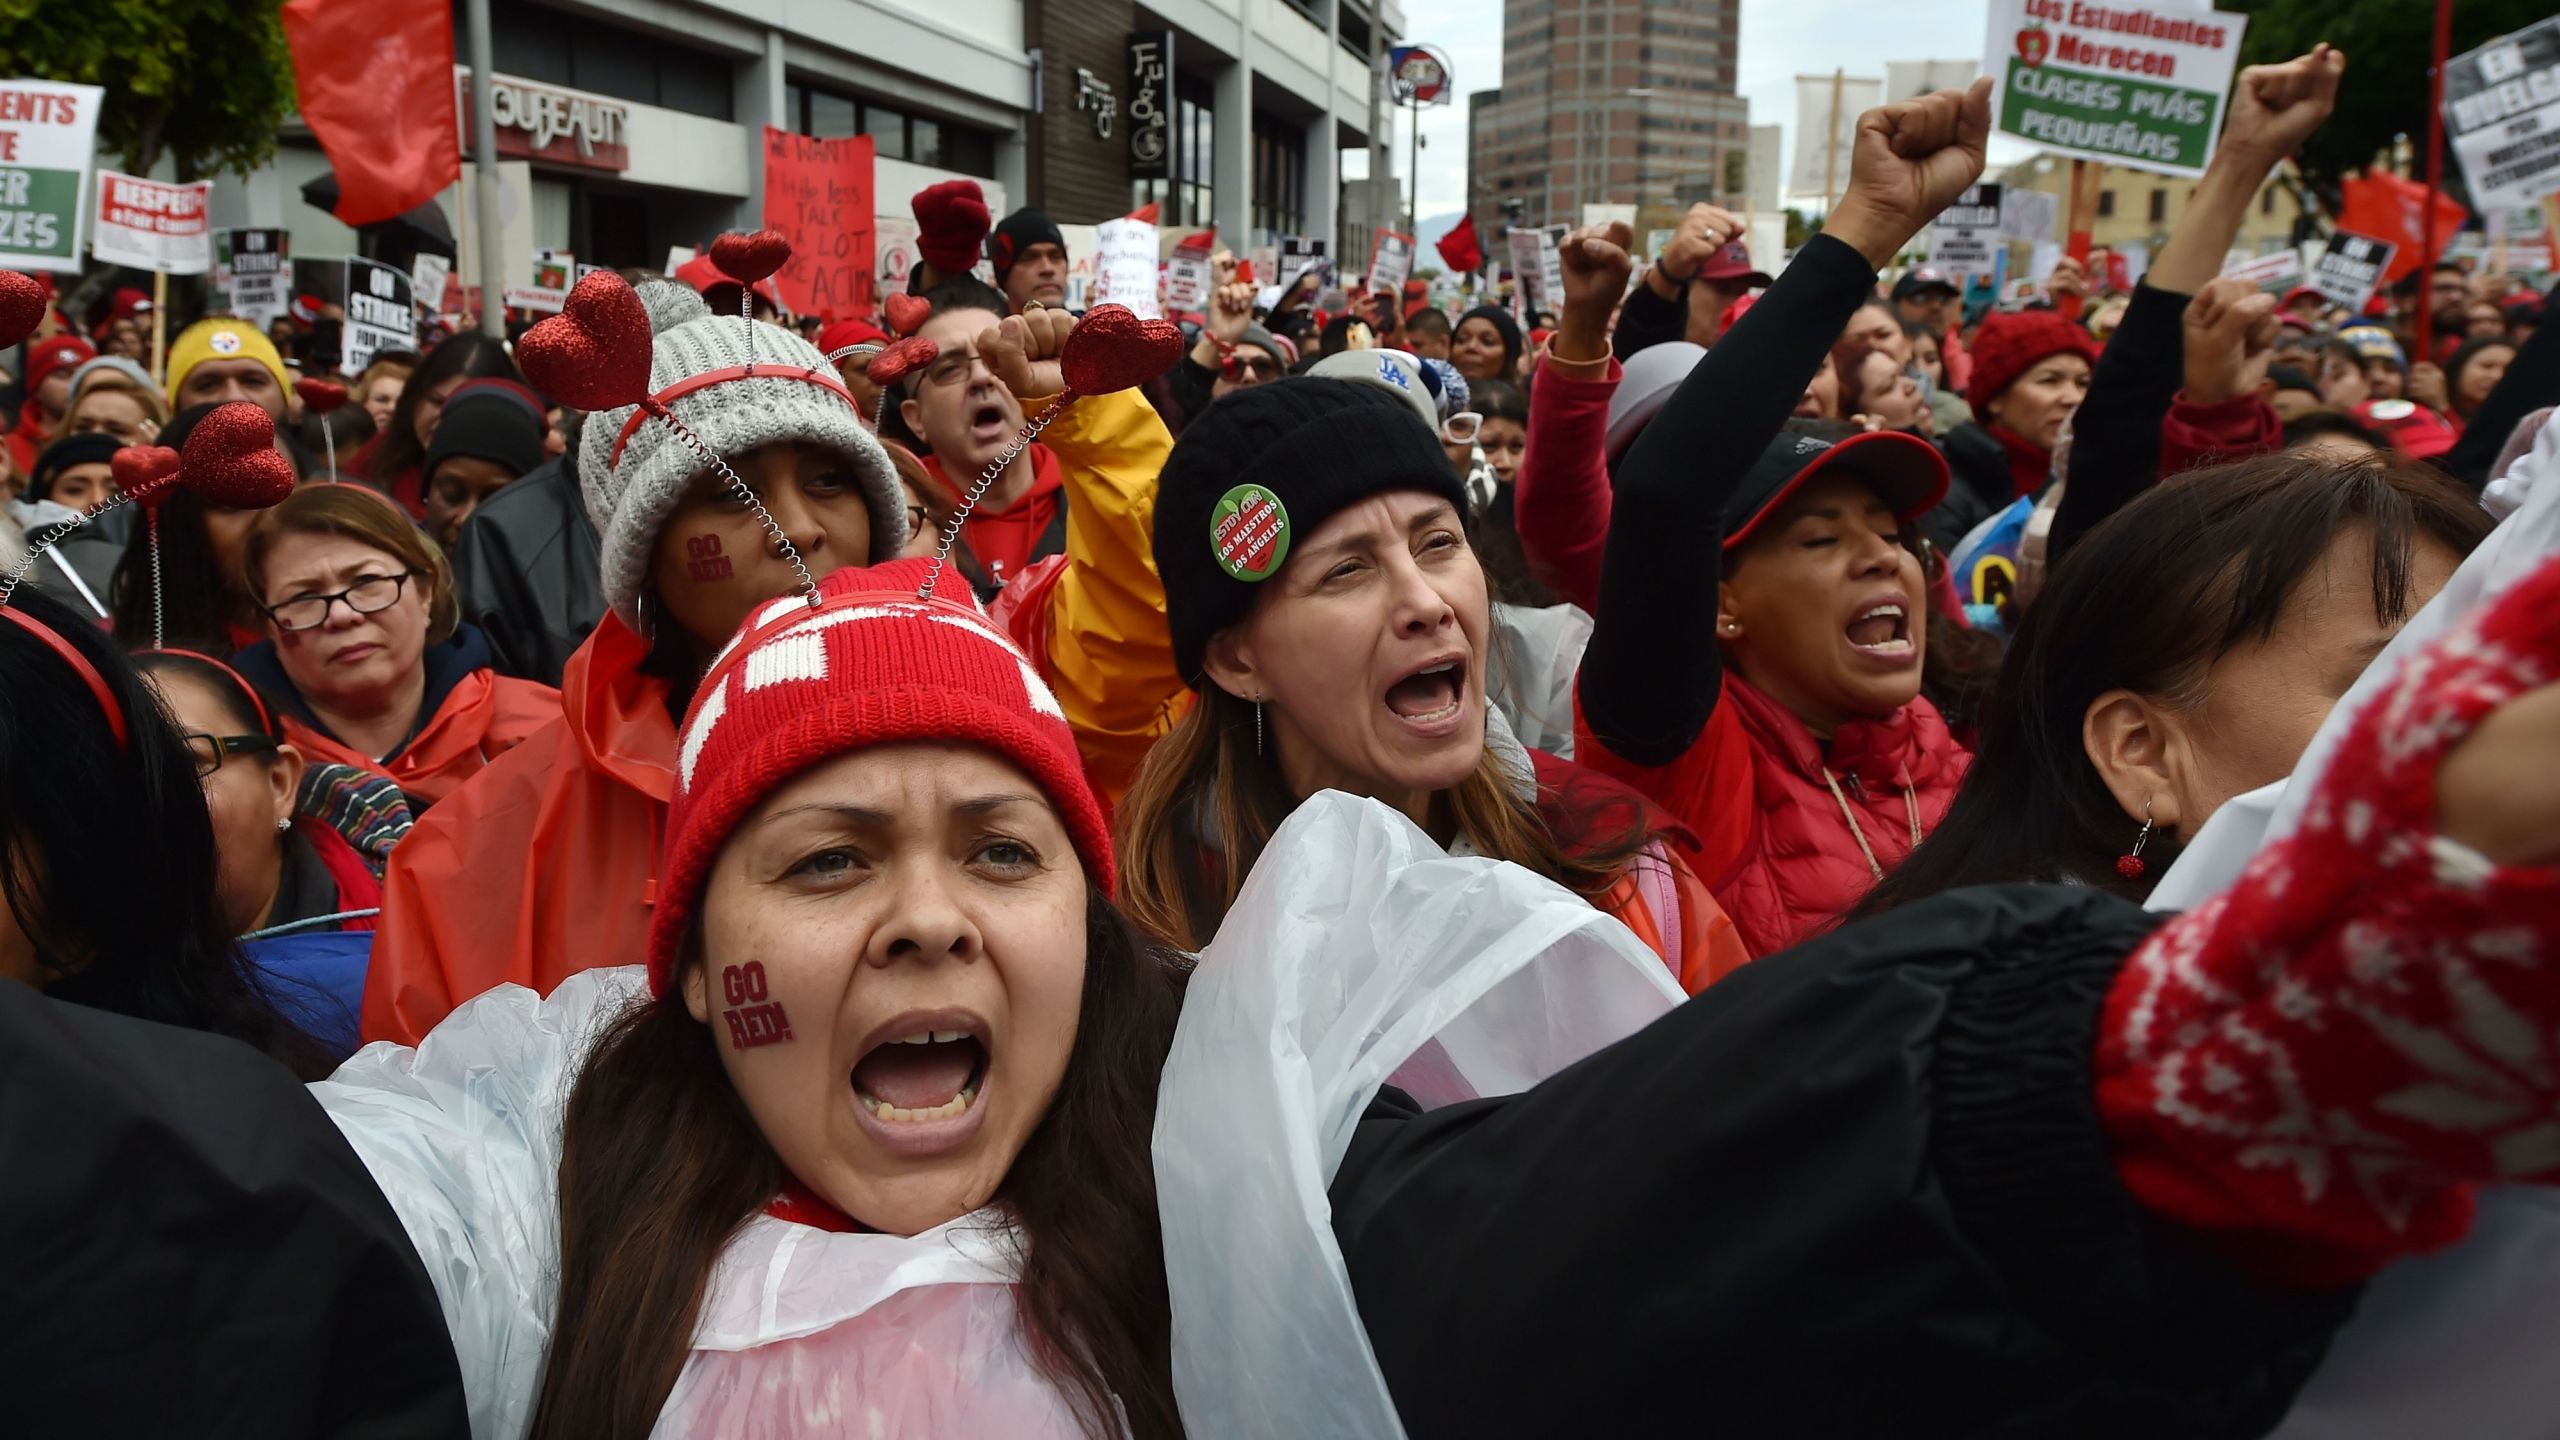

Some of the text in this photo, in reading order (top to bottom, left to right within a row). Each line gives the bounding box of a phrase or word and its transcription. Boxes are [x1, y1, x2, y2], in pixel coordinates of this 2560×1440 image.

[2025, 0, 2227, 49] Los Estudiantes
[2055, 33, 2177, 79] Merecen
[2013, 67, 2206, 126] CLASES MÁS
[794, 136, 851, 164] WANT
[2019, 108, 2181, 161] PEQUEÑAS
[796, 200, 842, 228] TALK
[817, 229, 868, 260] LOT
[370, 267, 395, 300] ON
[350, 290, 411, 333] STRIKE
[1378, 354, 1410, 392] LA
[1213, 489, 1263, 542] ESTOY CON
[1217, 541, 1235, 562] LOS
[1232, 499, 1278, 546] MAESTROS
[687, 533, 722, 560] GO
[1230, 553, 1248, 574] LOS
[1246, 517, 1285, 559] ANGELES
[722, 960, 769, 1006] GO
[722, 1001, 795, 1051] RED!
